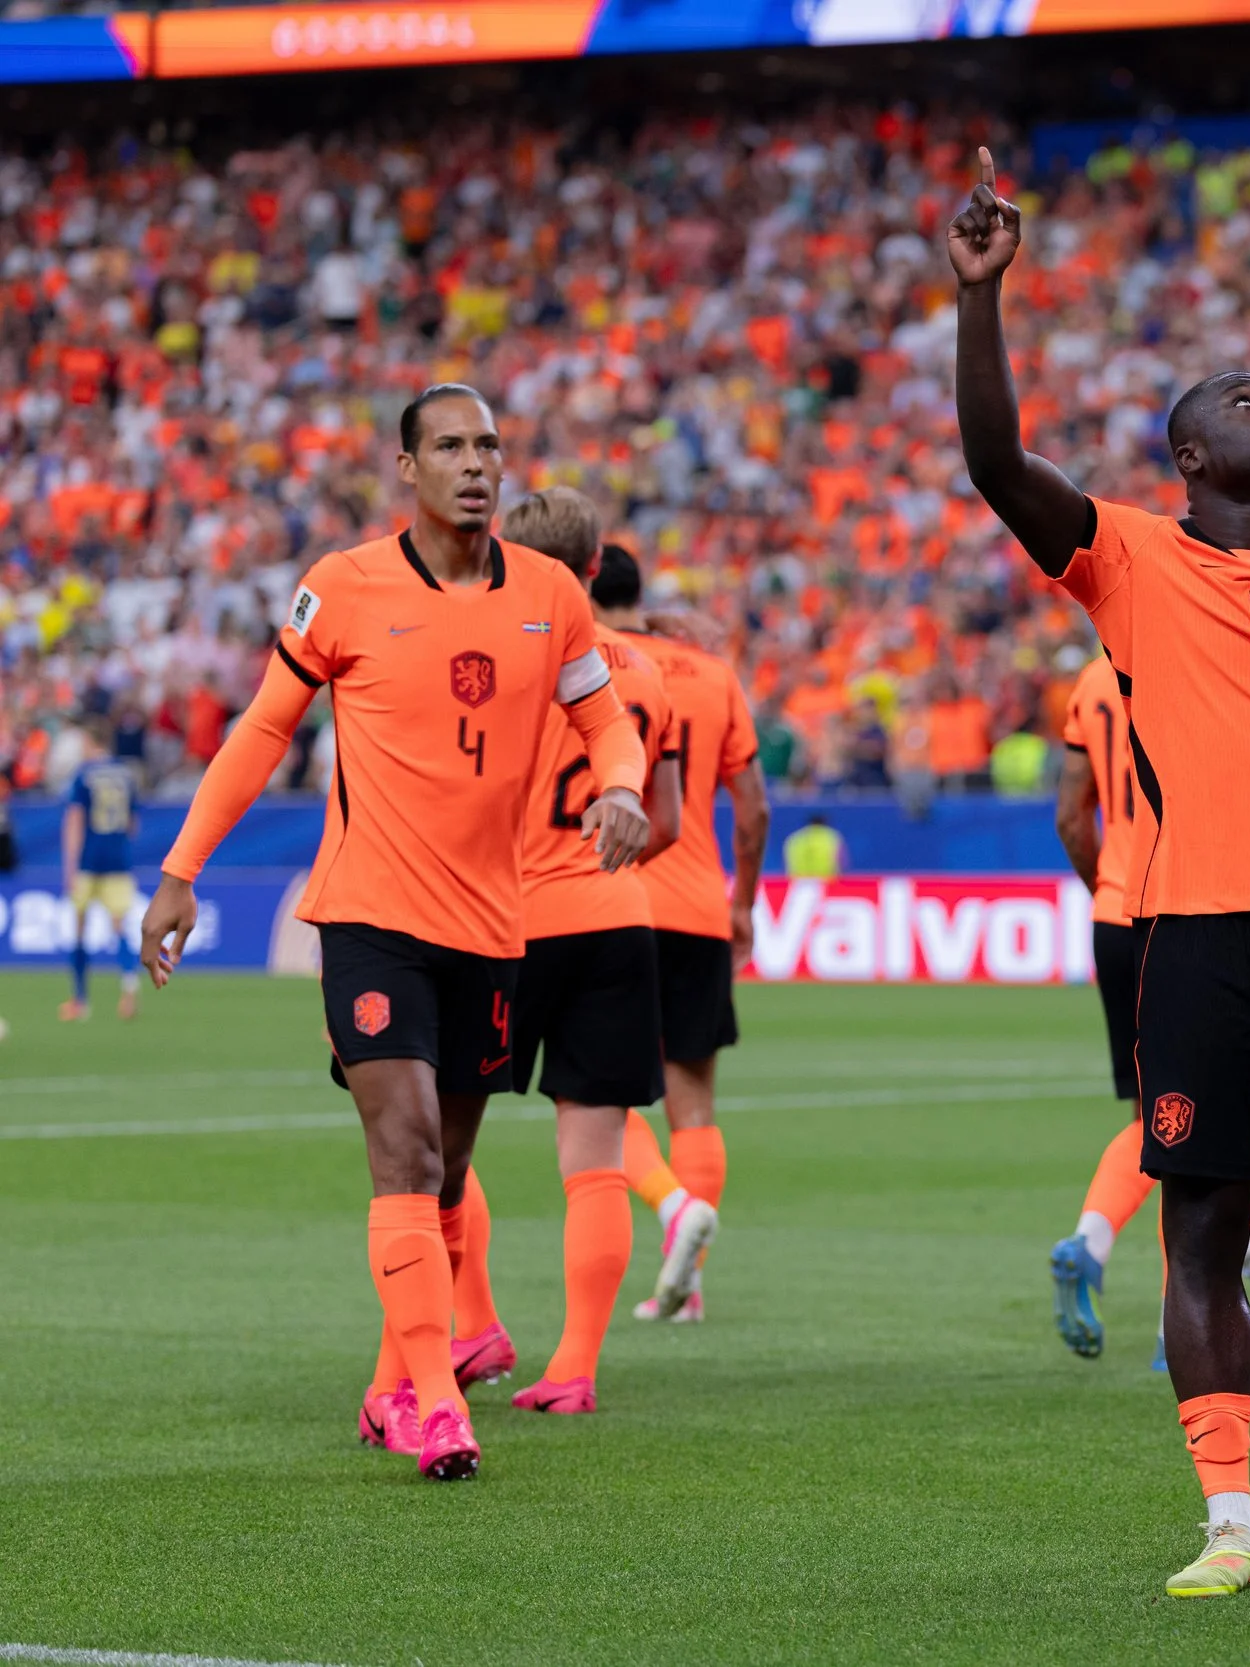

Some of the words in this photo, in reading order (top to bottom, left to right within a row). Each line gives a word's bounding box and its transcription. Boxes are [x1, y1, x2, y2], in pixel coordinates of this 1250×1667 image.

[457, 715, 486, 777] 4
[752, 877, 1098, 983] Valvol
[491, 990, 510, 1048] 4
